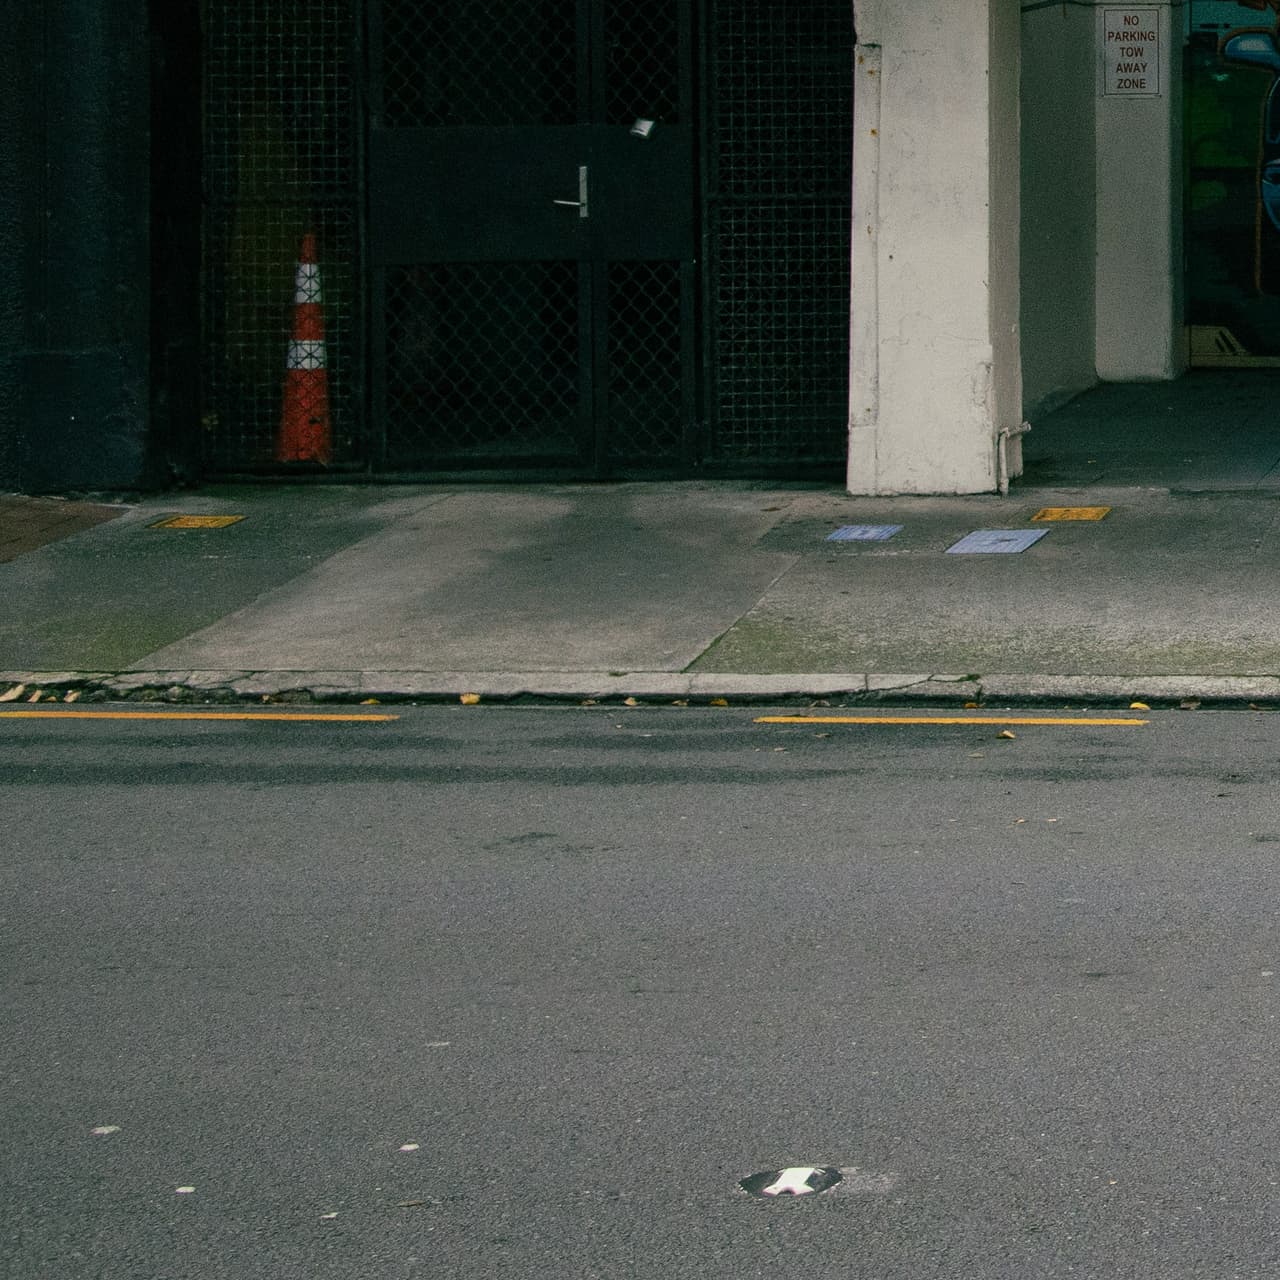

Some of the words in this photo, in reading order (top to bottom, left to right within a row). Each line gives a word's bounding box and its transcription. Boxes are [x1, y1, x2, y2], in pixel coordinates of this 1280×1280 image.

[1123, 16, 1139, 26] NO
[1108, 31, 1155, 41] PARKING
[1120, 47, 1144, 57] TOW
[1116, 63, 1148, 73] AWAY
[1117, 79, 1146, 89] ZONE
